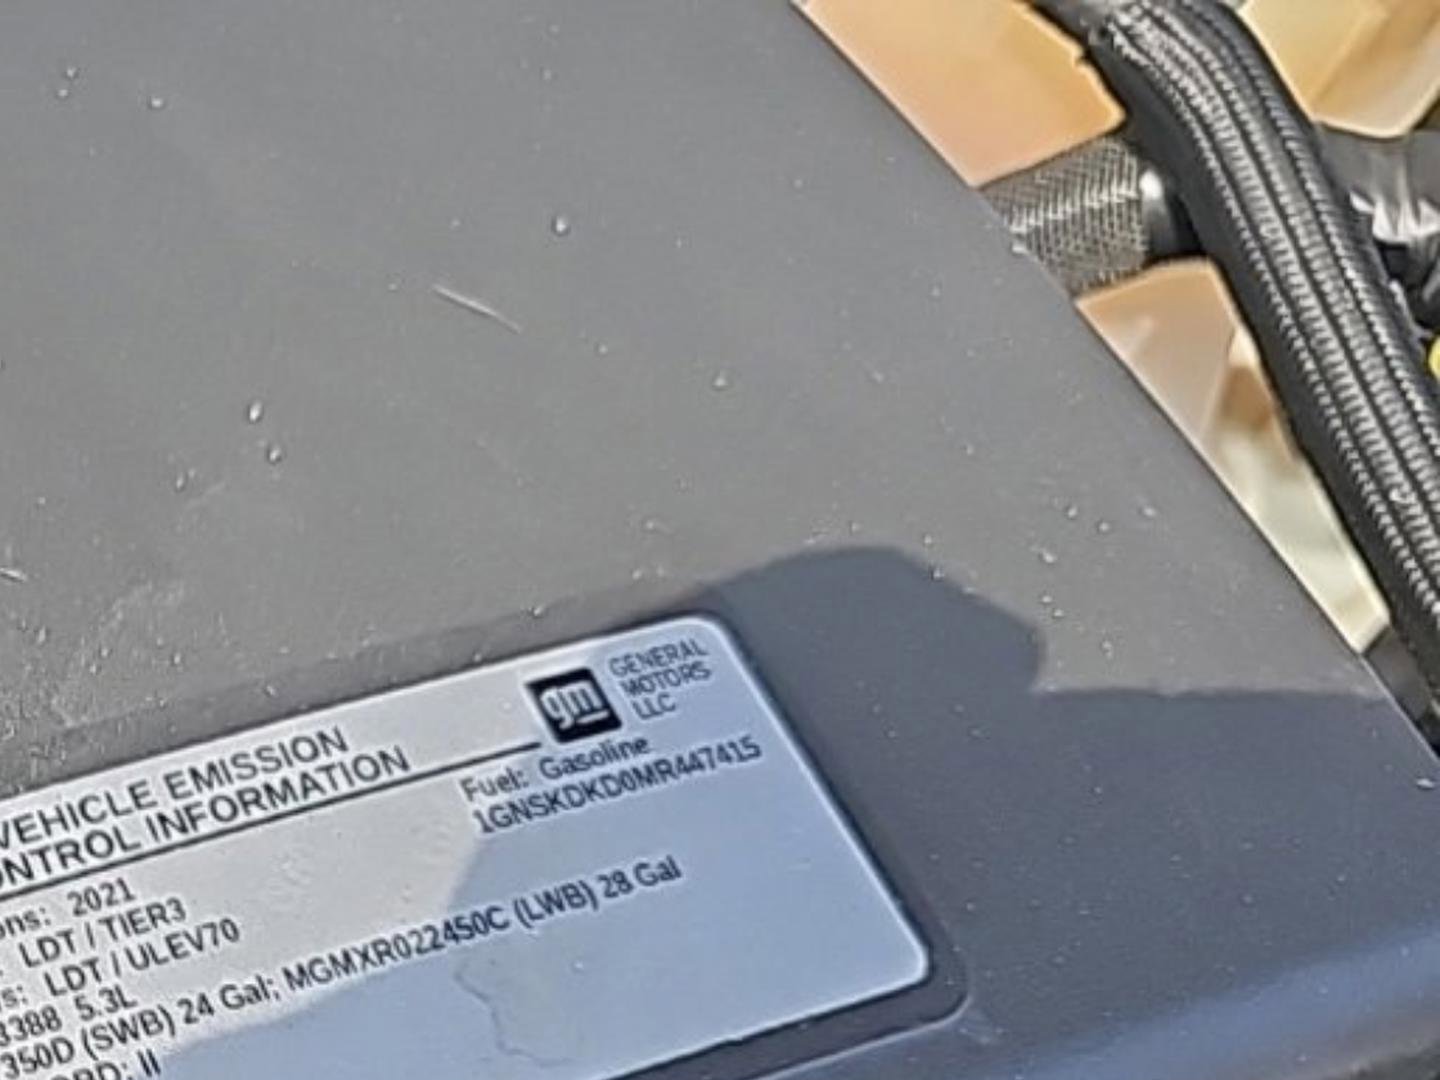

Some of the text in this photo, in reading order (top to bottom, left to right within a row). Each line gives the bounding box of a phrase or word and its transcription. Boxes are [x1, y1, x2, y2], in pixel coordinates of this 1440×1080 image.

[609, 638, 708, 677] GENERAL
[620, 661, 712, 697] MOTORS
[631, 694, 677, 720] LLC
[164, 725, 350, 801] EMISSION
[460, 736, 650, 801] Fuel: Gasoline
[144, 745, 412, 842] INFORMATION
[67, 877, 136, 917] 2021
[18, 928, 76, 968] LDT
[98, 897, 186, 941] TIER3
[44, 957, 102, 997] LDT
[126, 918, 240, 972] ULEV70
[81, 1004, 175, 1060] (SWB)
[177, 993, 214, 1025] 24
[219, 974, 280, 1010] Gal;
[283, 904, 510, 993] MGMXR022450C
[513, 878, 599, 930] (LWB)
[597, 870, 633, 900] 28
[633, 855, 683, 887] Gal
[75, 984, 137, 1021] 5.3L
[137, 1048, 161, 1078] II
